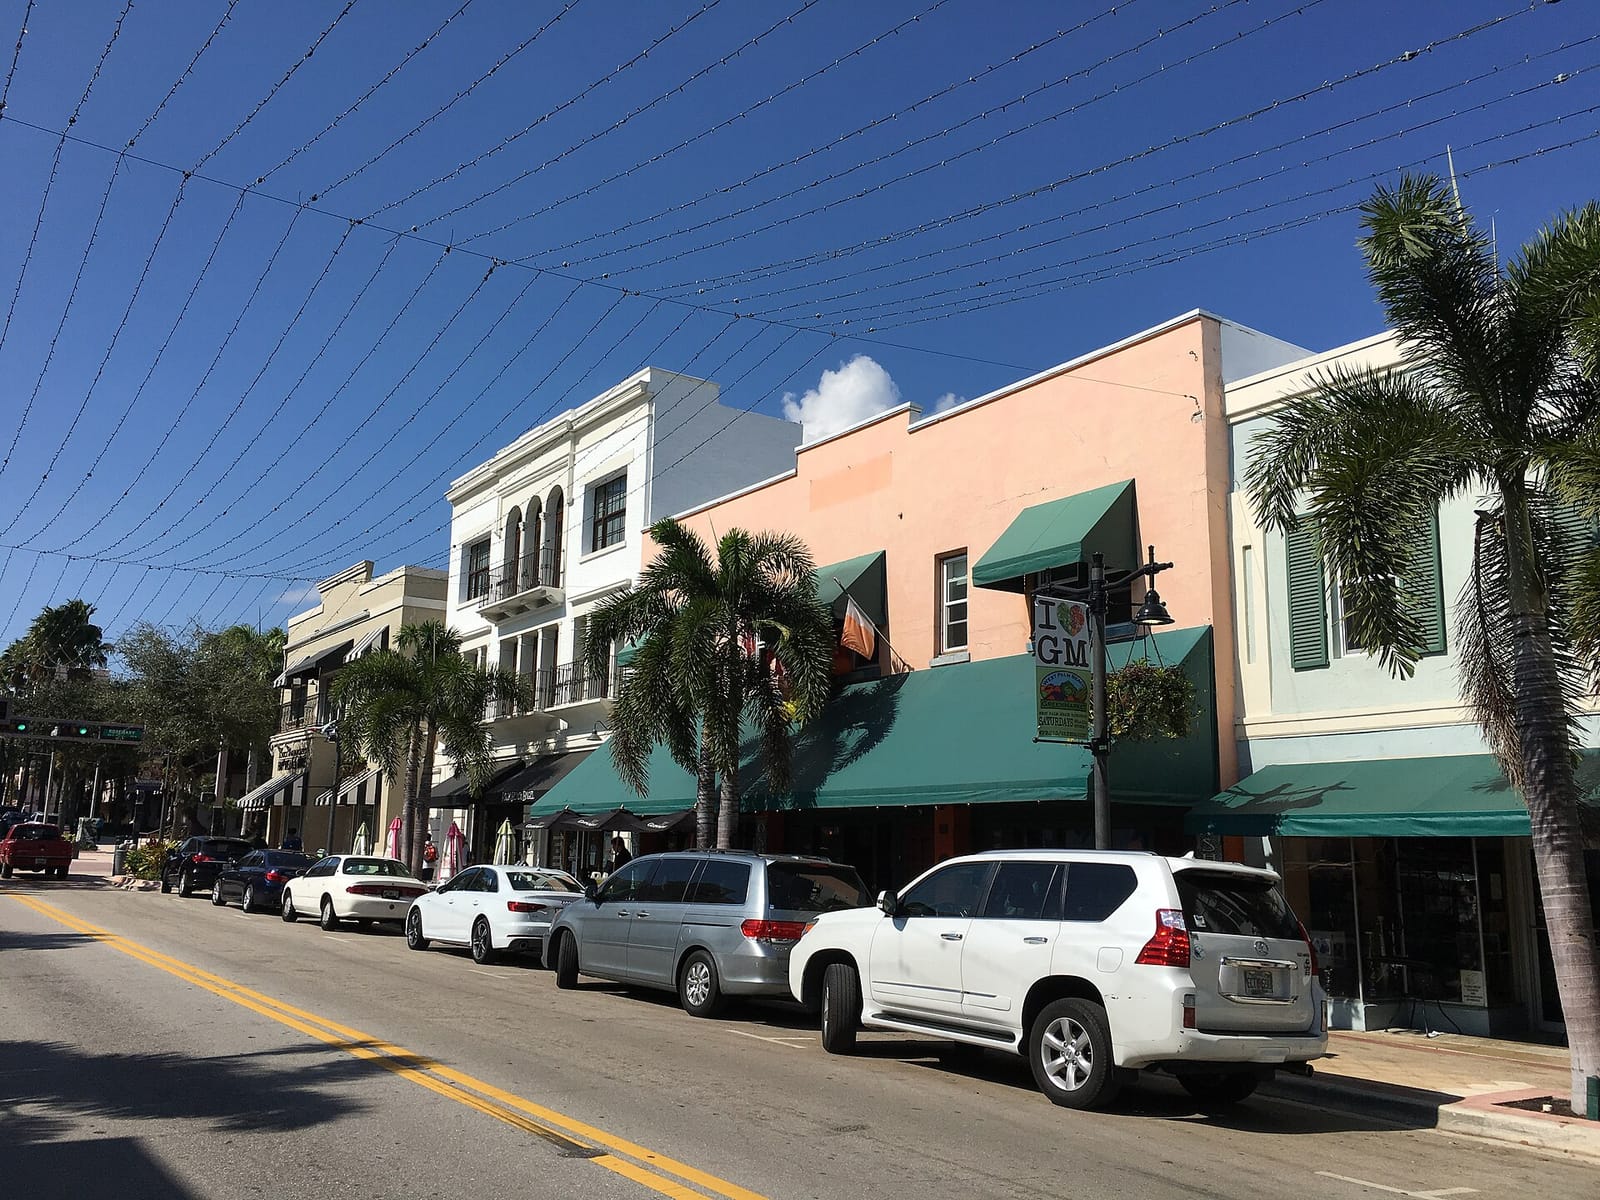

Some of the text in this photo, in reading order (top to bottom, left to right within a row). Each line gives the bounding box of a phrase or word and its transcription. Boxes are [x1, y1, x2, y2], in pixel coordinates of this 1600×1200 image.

[1039, 600, 1056, 630] I
[1038, 635, 1089, 667] GM
[1039, 716, 1074, 727] SATURDAYS
